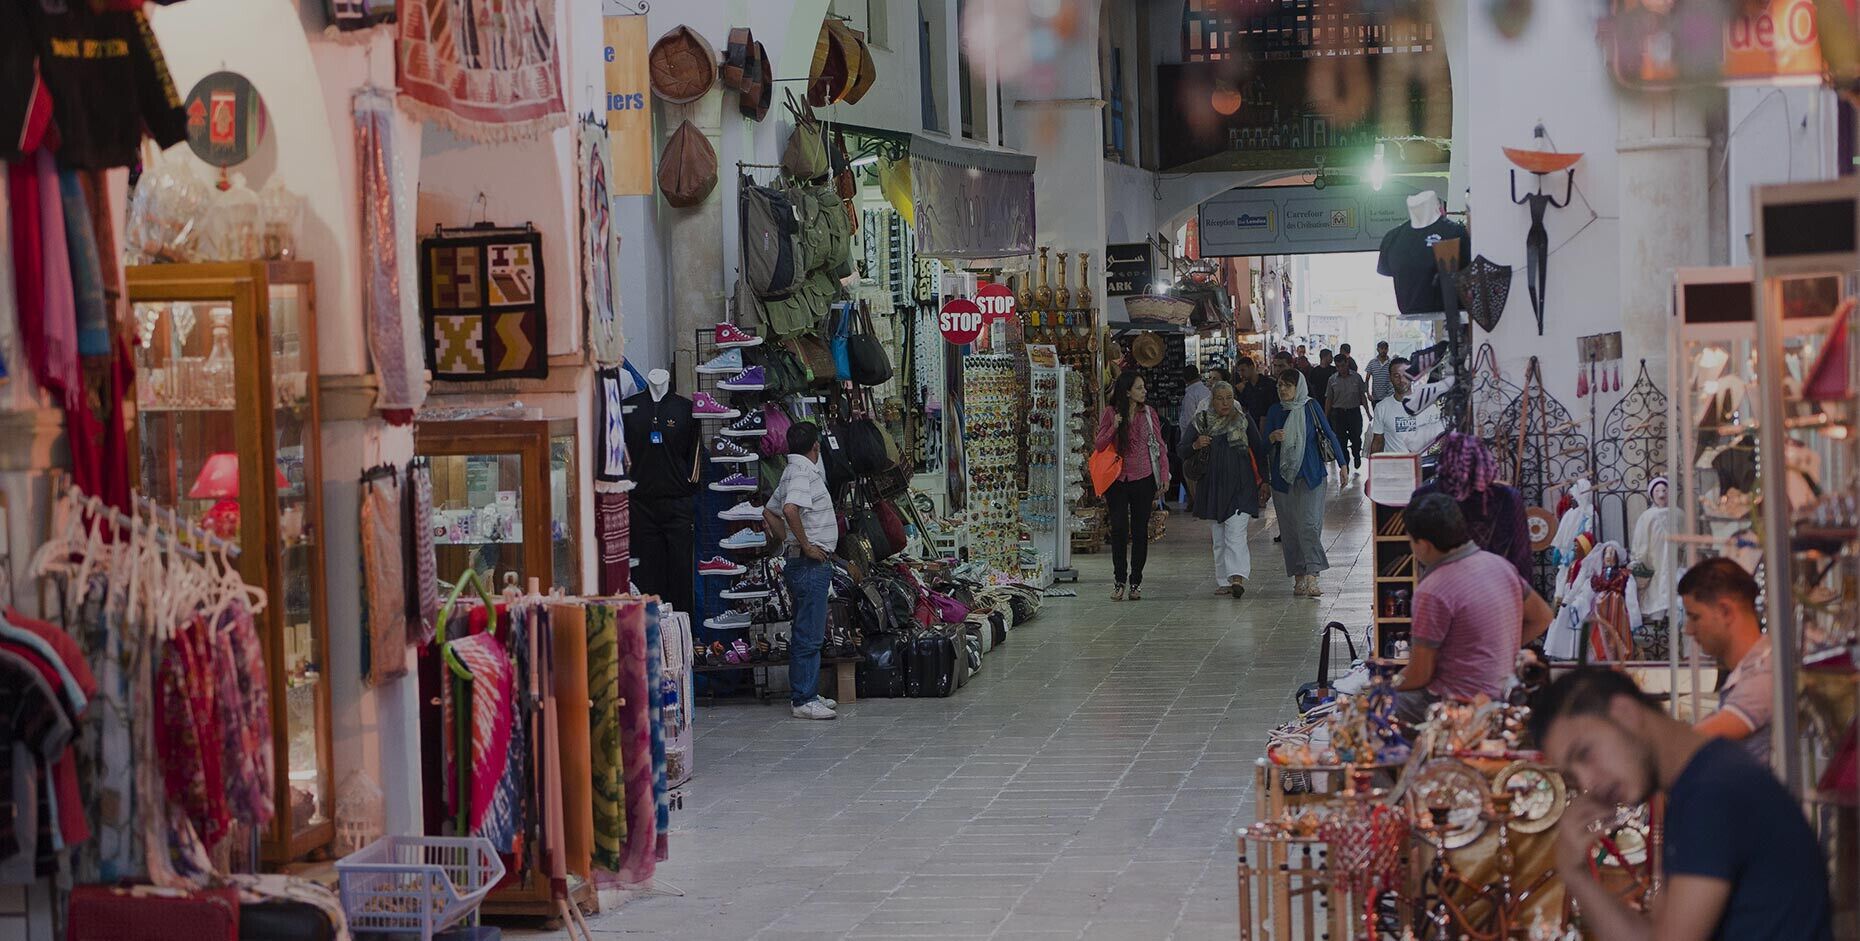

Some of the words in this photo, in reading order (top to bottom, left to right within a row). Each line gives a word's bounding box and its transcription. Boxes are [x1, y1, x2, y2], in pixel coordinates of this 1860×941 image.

[607, 92, 644, 111] iers
[1286, 210, 1324, 218] Carrefour
[1205, 218, 1236, 227] Réception
[1286, 221, 1297, 229] des
[976, 296, 1015, 314] STOP
[940, 312, 982, 332] STOP
